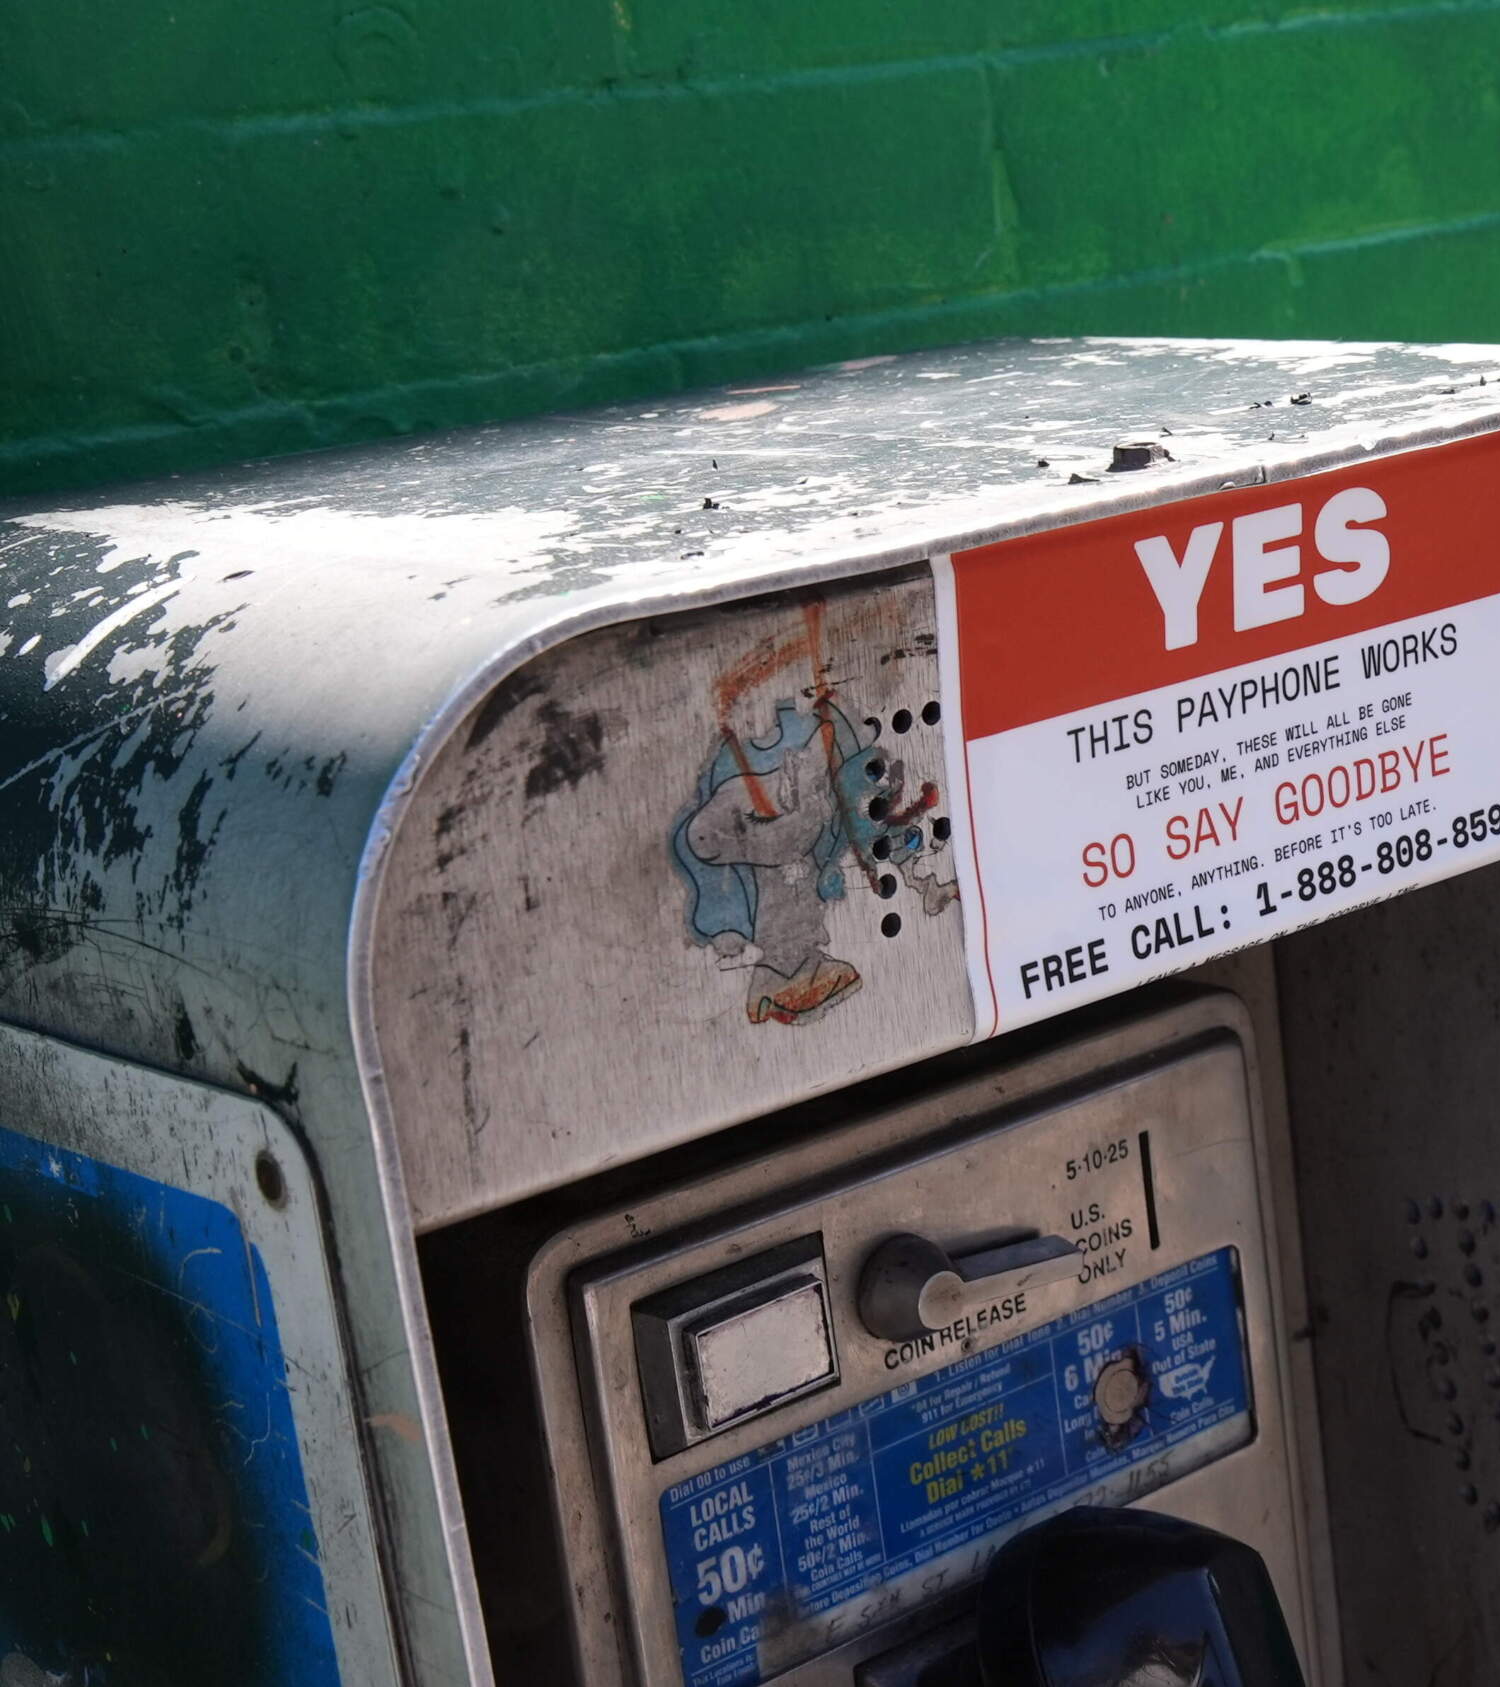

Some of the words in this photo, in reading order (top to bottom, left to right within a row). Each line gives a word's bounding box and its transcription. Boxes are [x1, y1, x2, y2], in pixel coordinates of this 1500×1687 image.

[1134, 487, 1391, 651] YES
[1067, 709, 1154, 763] THIS
[1177, 655, 1341, 733] PAYPHONE
[1361, 623, 1458, 679] WORKS
[1126, 769, 1151, 790] BUT
[1161, 749, 1227, 778] SOMEDAY,
[1236, 732, 1278, 756] THESE
[1285, 721, 1318, 742] WILL
[1326, 711, 1351, 730] ALL
[1359, 703, 1374, 722] BE
[1382, 692, 1413, 714] GONE
[1136, 789, 1170, 809] LIKE
[1179, 776, 1212, 798] YOU,
[1221, 765, 1245, 784] ME,
[1254, 753, 1279, 773] AND
[1287, 727, 1368, 763] EVERYTHING
[1376, 715, 1407, 737] ELSE
[1082, 833, 1136, 888] SO
[1166, 796, 1244, 860] SAY
[1275, 733, 1450, 825] GOODBYE
[1098, 904, 1117, 922] TO
[1124, 883, 1183, 913] ANYONE,
[1191, 855, 1265, 890] ANYTHING.
[1274, 834, 1323, 863] BEFORE
[1331, 821, 1363, 846] IT'S
[1369, 811, 1393, 831] TOO
[1400, 798, 1437, 821] LATE.
[1020, 938, 1110, 1000] FREE
[1131, 905, 1232, 961] CALL:
[1071, 1203, 1105, 1230] U.S.
[1075, 1219, 1134, 1255] COINS
[1078, 1249, 1128, 1285] ONLY
[1164, 1286, 1193, 1314] 50¢
[884, 1335, 935, 1370] COIN
[940, 1293, 1027, 1347] RELEASE
[1077, 1320, 1114, 1356] 50¢
[1154, 1321, 1166, 1342] 5
[1169, 1307, 1208, 1335] Min.
[1172, 1333, 1195, 1352] USA
[949, 1355, 982, 1377] Listen
[985, 1348, 999, 1363] for
[1151, 1355, 1172, 1376] Out
[1174, 1349, 1186, 1366] of
[1187, 1338, 1216, 1360] State
[1064, 1364, 1079, 1392] 6
[928, 1423, 958, 1451] LOW
[1064, 1412, 1093, 1434] Long
[787, 1444, 830, 1473] Mexico
[910, 1439, 977, 1486] Collect
[980, 1418, 1028, 1454] Calls
[669, 1481, 695, 1504] Dial
[714, 1467, 726, 1485] to
[730, 1457, 751, 1474] use
[804, 1473, 848, 1499] Mexico
[832, 1483, 864, 1505] Min.
[926, 1470, 965, 1505] Dial
[690, 1481, 755, 1528] LOCAL
[810, 1511, 837, 1535] Rest
[839, 1503, 853, 1522] of
[693, 1505, 757, 1552] CALLS
[805, 1530, 824, 1551] the
[827, 1515, 860, 1541] World
[696, 1542, 765, 1606] 50¢
[810, 1561, 835, 1583] Coin
[836, 1549, 864, 1571] Calls
[700, 1635, 736, 1665] Coin
